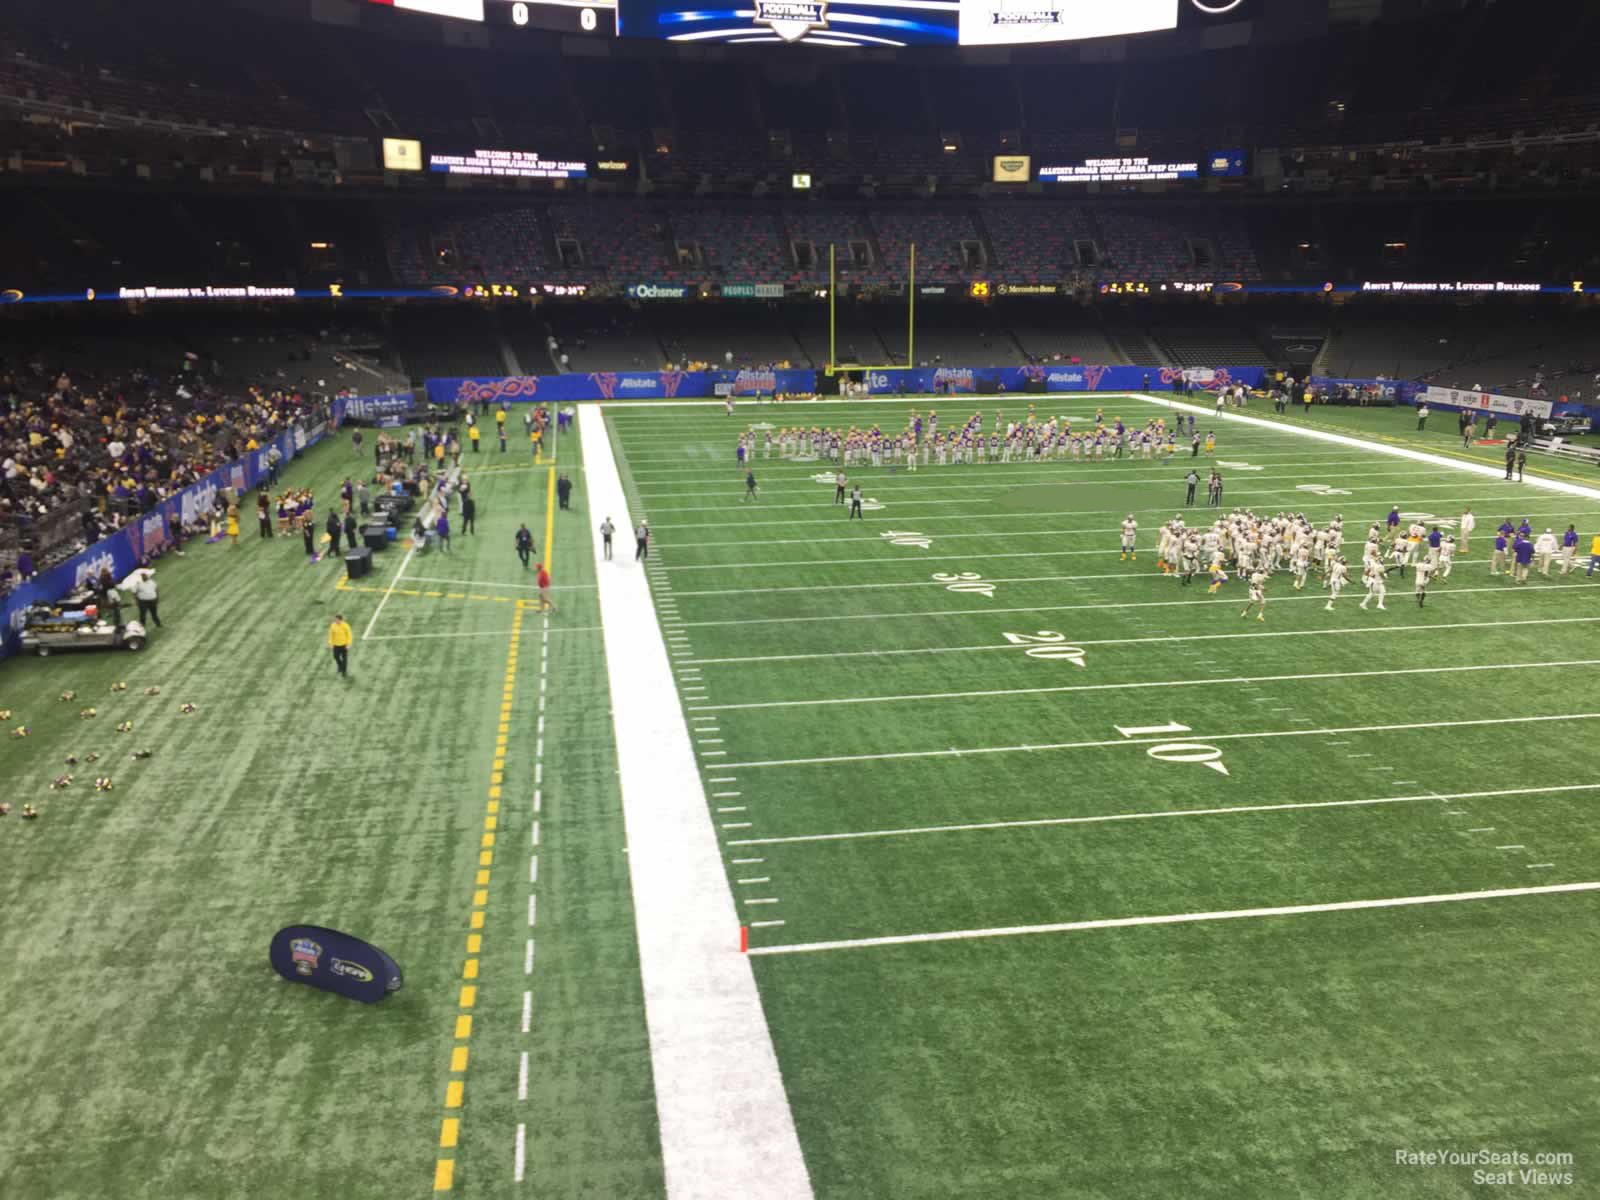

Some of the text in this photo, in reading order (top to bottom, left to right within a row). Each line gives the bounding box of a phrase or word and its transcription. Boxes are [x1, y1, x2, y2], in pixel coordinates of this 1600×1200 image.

[512, 2, 529, 26] 0
[580, 7, 597, 31] 0
[475, 150, 538, 161] WELCOME TO THE
[431, 155, 465, 165] ALLSTATE
[466, 157, 490, 167] SUGAR
[538, 161, 557, 170] PREP
[558, 162, 587, 171] CLASSIC
[598, 161, 628, 170] verizon
[1085, 157, 1149, 167] WELCOME TO THE
[1040, 167, 1073, 175] ALLSTATE
[1074, 167, 1099, 175] SUGAR
[1168, 163, 1198, 172] CLASSIC
[206, 286, 246, 297] LUTCHER
[247, 286, 296, 297] BULLDOGS
[636, 284, 684, 297] Ochsner
[723, 286, 754, 296] PEOPLES
[1009, 284, 1056, 293] Mercedes-Benz
[1456, 281, 1494, 290] LUTCHER
[1495, 282, 1541, 291] BULLDOGS
[738, 369, 775, 381] Allstate
[936, 367, 973, 379] Allstate
[1048, 372, 1082, 383] Allstate
[620, 377, 656, 389] Allstate
[931, 571, 997, 592] 30
[1002, 630, 1087, 659] 20
[1112, 720, 1223, 762] 10
